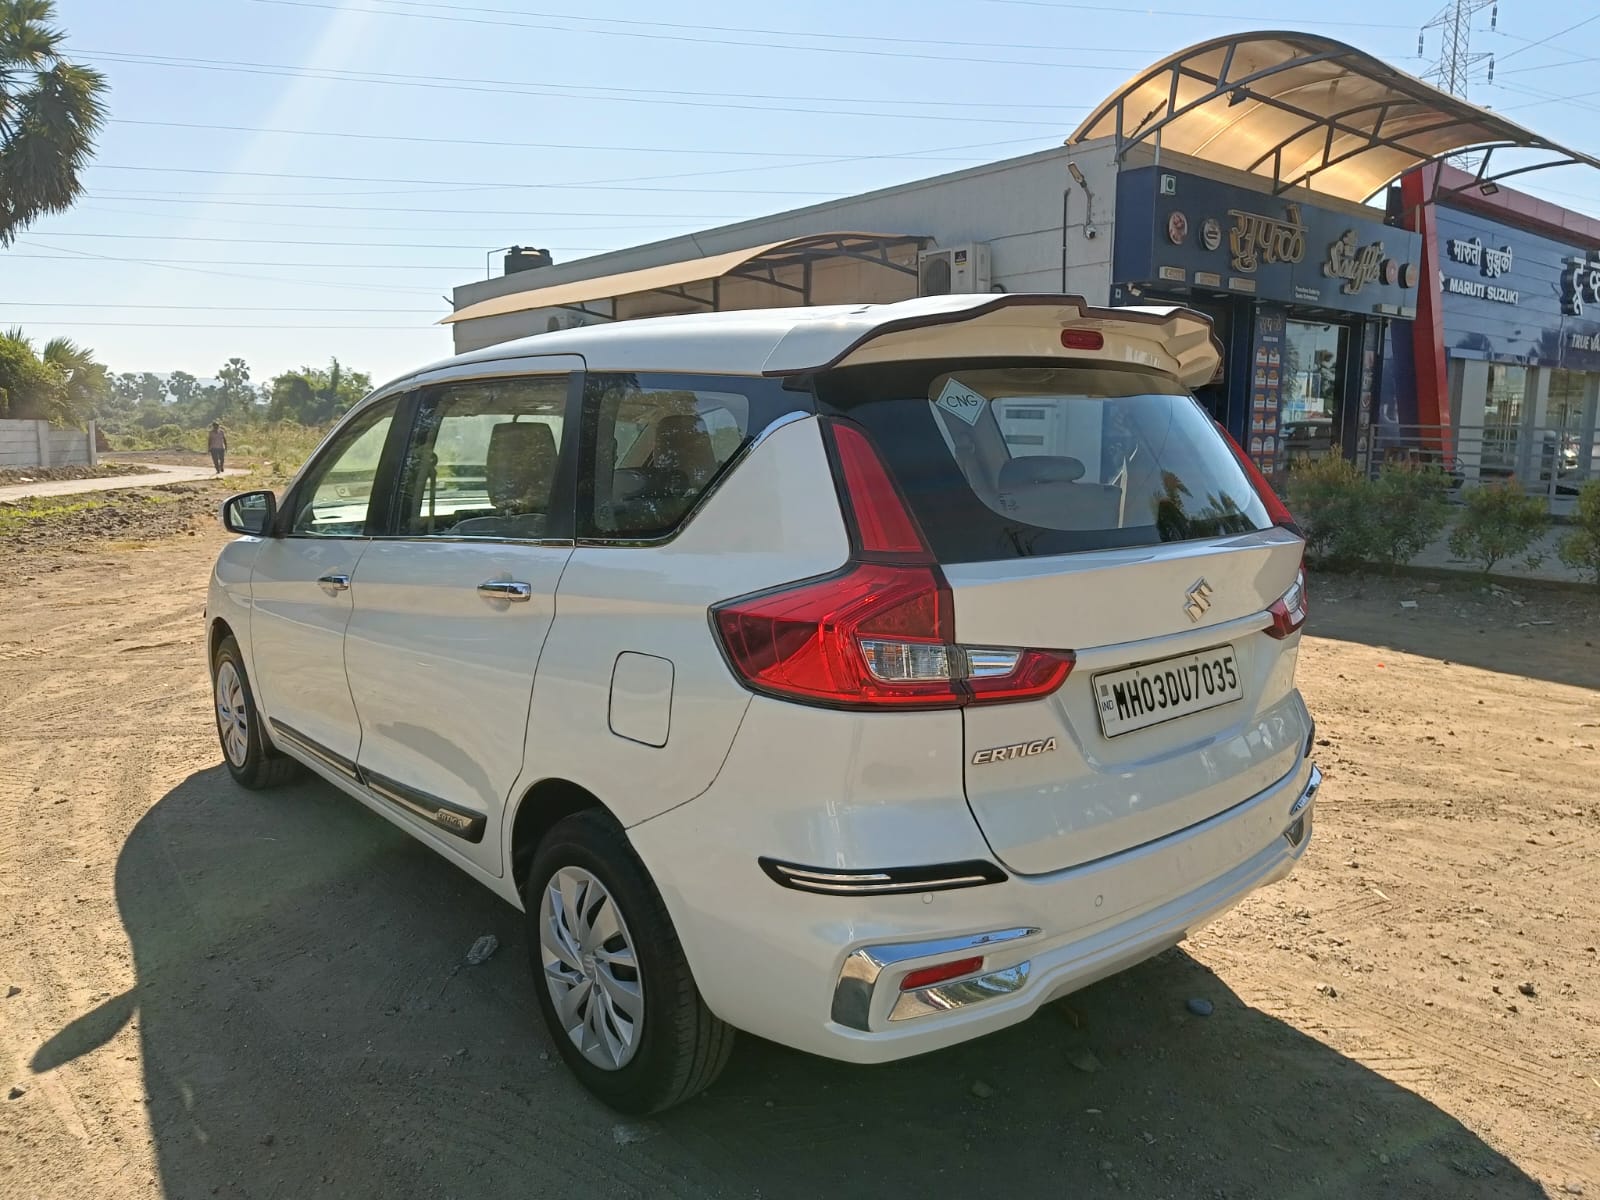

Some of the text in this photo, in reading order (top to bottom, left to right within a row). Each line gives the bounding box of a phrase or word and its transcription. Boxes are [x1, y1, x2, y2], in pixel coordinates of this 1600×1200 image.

[1453, 236, 1513, 278] मारुती सुझुकी
[1449, 278, 1519, 304] MARUTI SUZUKI
[1571, 334, 1590, 350] TRUE
[946, 394, 978, 408] CNG
[1113, 656, 1237, 721] MH03DU7035
[1102, 699, 1114, 711] IND
[972, 737, 1057, 765] ERTIGA
